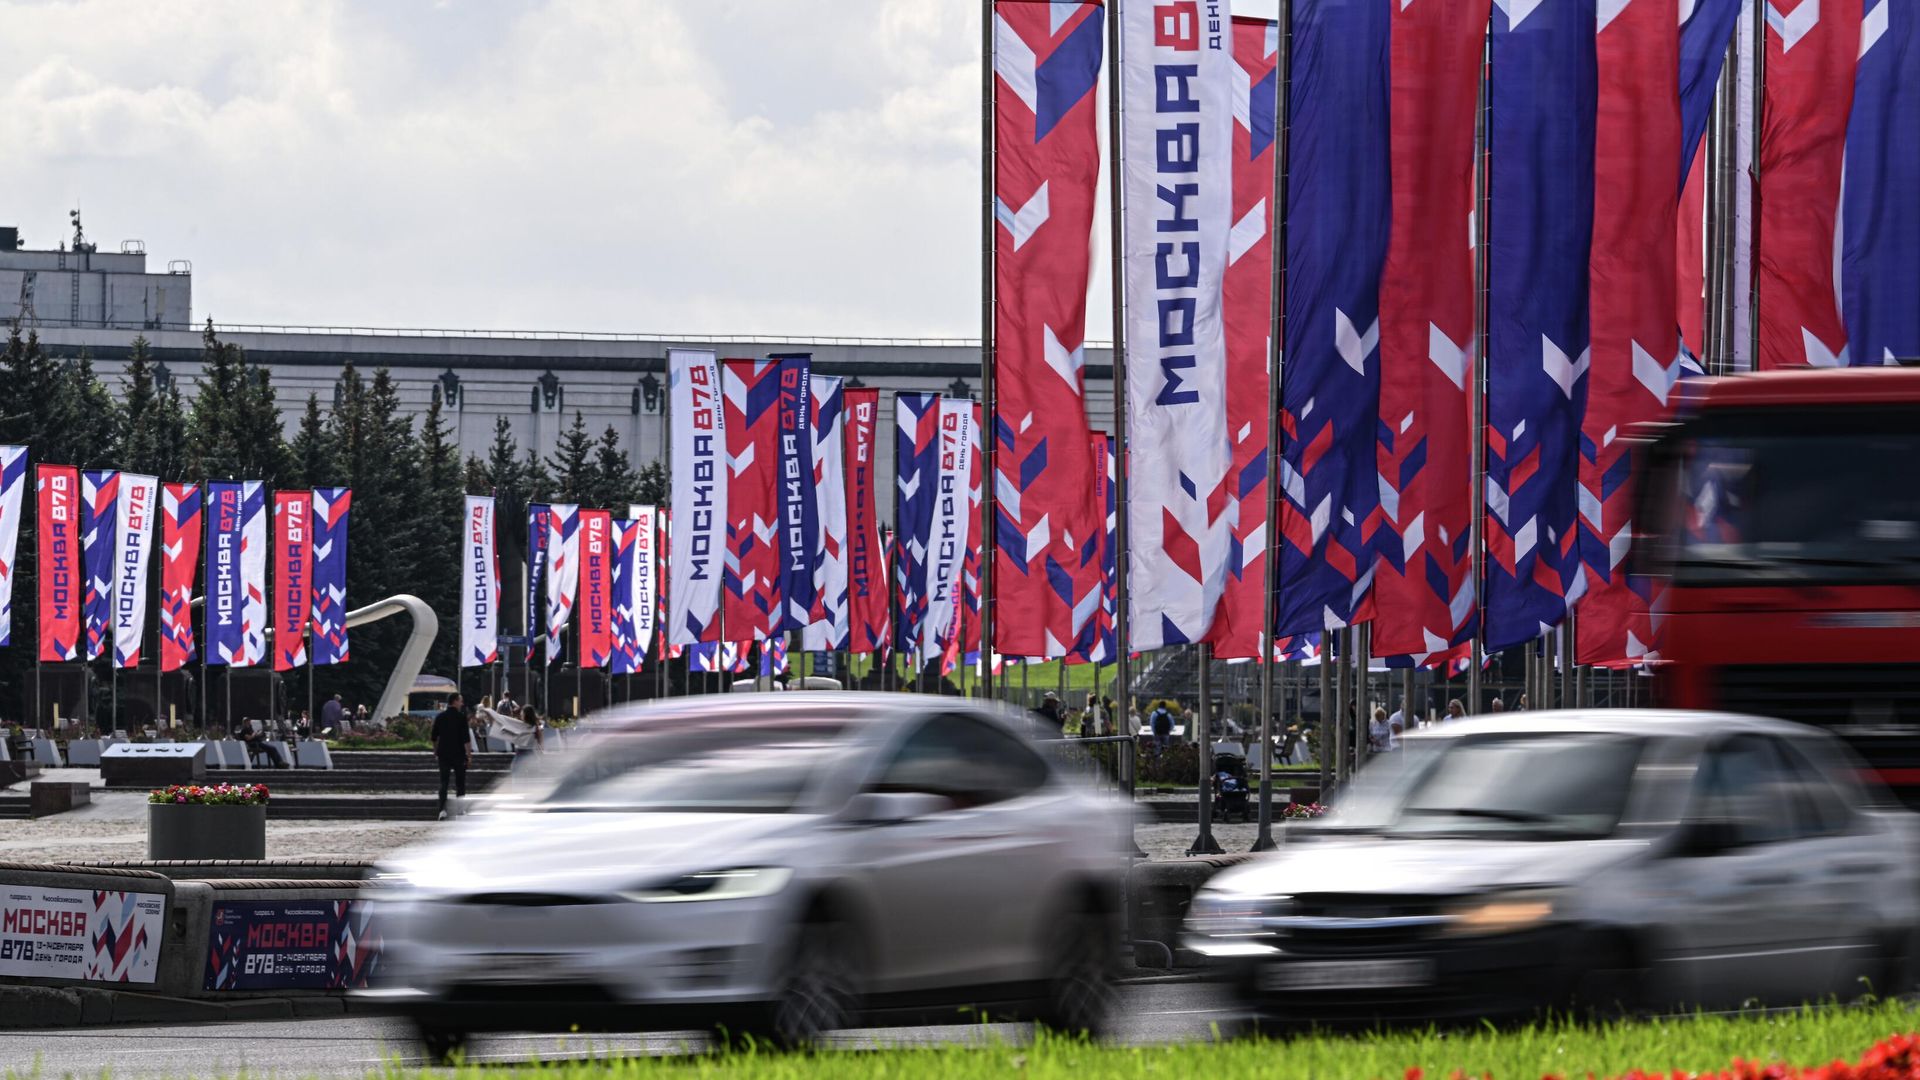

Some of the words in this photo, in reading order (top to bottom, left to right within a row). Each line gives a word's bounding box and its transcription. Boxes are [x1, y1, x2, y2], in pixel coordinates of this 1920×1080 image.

[1206, 0, 1222, 50] ДЕН
[1154, 64, 1200, 406] МОСКВА
[3, 907, 87, 937] МОСКВА
[247, 922, 329, 948] МОСКВА
[0, 939, 34, 961] 878
[35, 953, 52, 962] ДЕНЬ
[54, 954, 83, 964] ГОРОДА
[244, 954, 275, 974] 878
[275, 965, 293, 974] ДЕНЬ
[295, 965, 326, 974] ГОРОДА
